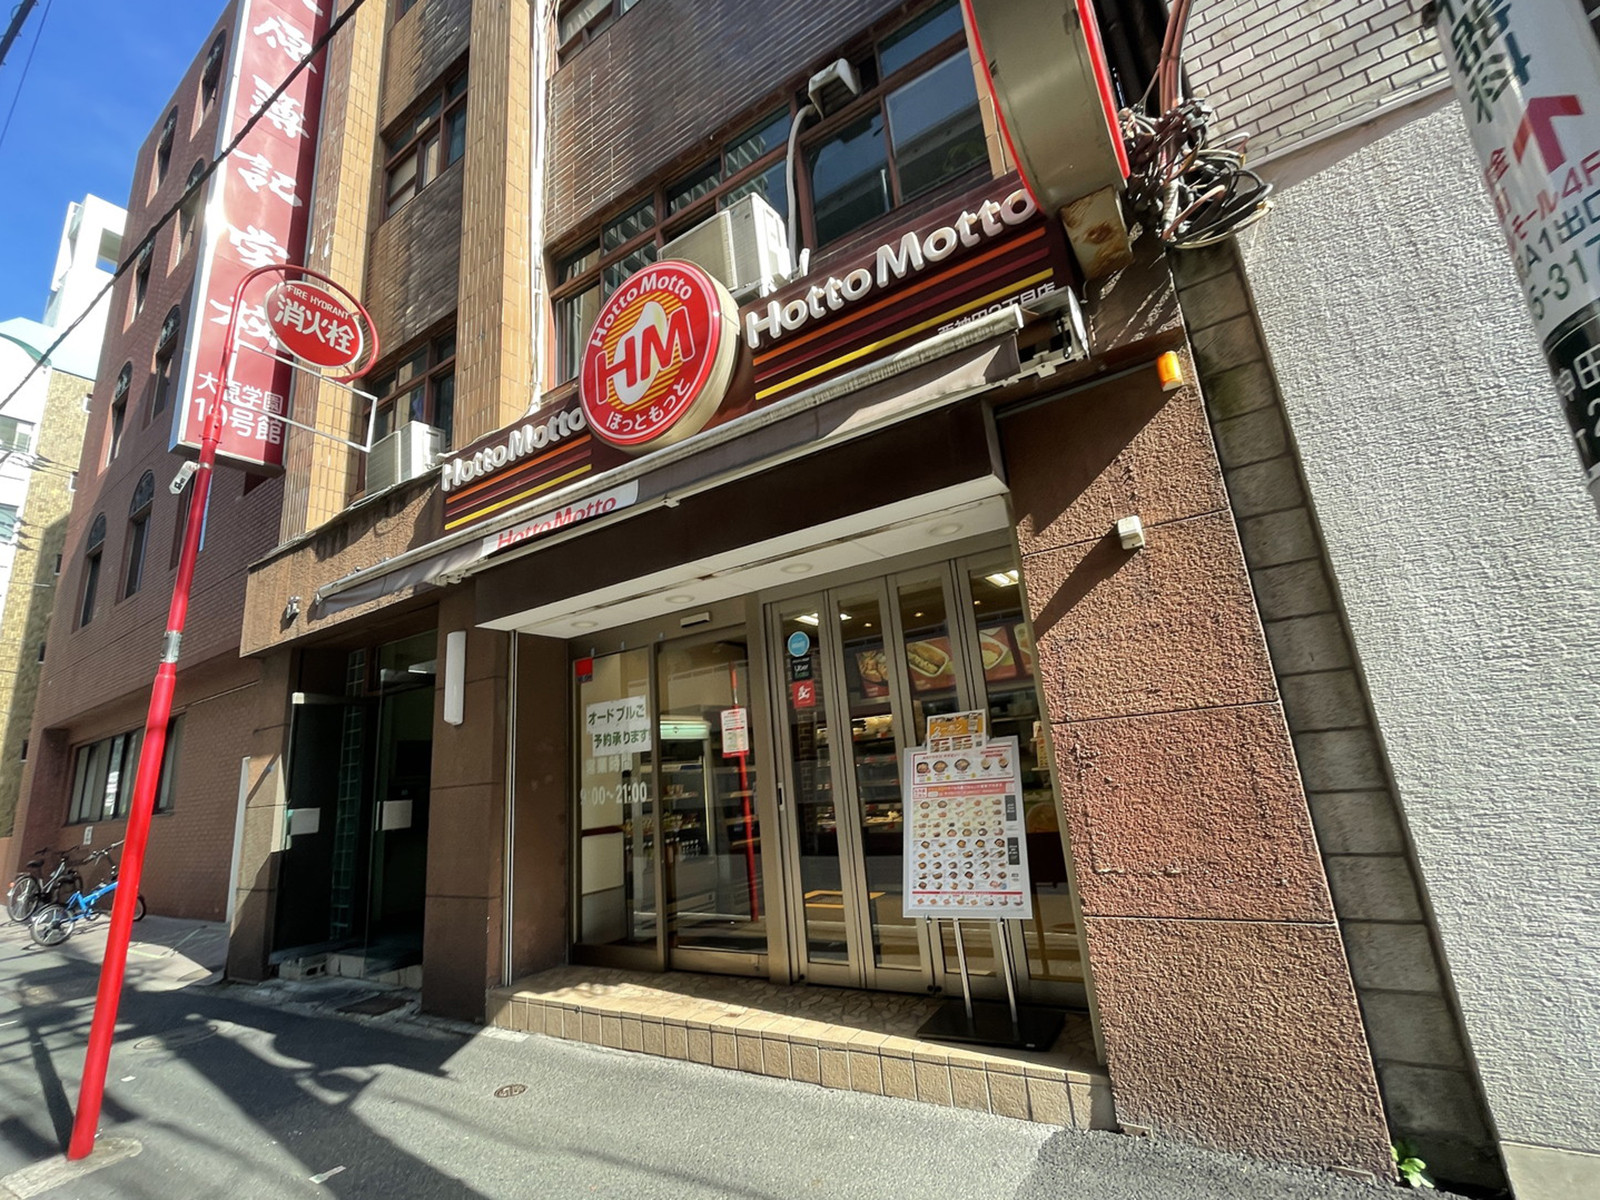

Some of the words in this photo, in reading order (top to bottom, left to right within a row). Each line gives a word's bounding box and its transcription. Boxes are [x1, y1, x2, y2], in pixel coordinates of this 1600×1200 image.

[210, 0, 323, 350] 原簿記学校
[745, 188, 1037, 350] HottoMotto
[275, 294, 355, 355] 消火栓
[286, 285, 309, 301] FIRE
[310, 295, 350, 320] HYDRANT
[591, 273, 693, 348] HottoMotto
[197, 372, 283, 414] 大原学園
[605, 377, 692, 431] ほっともっと
[441, 407, 587, 492] HottoMotto
[588, 704, 645, 726] オードブルご
[594, 729, 649, 749] 予約承ります
